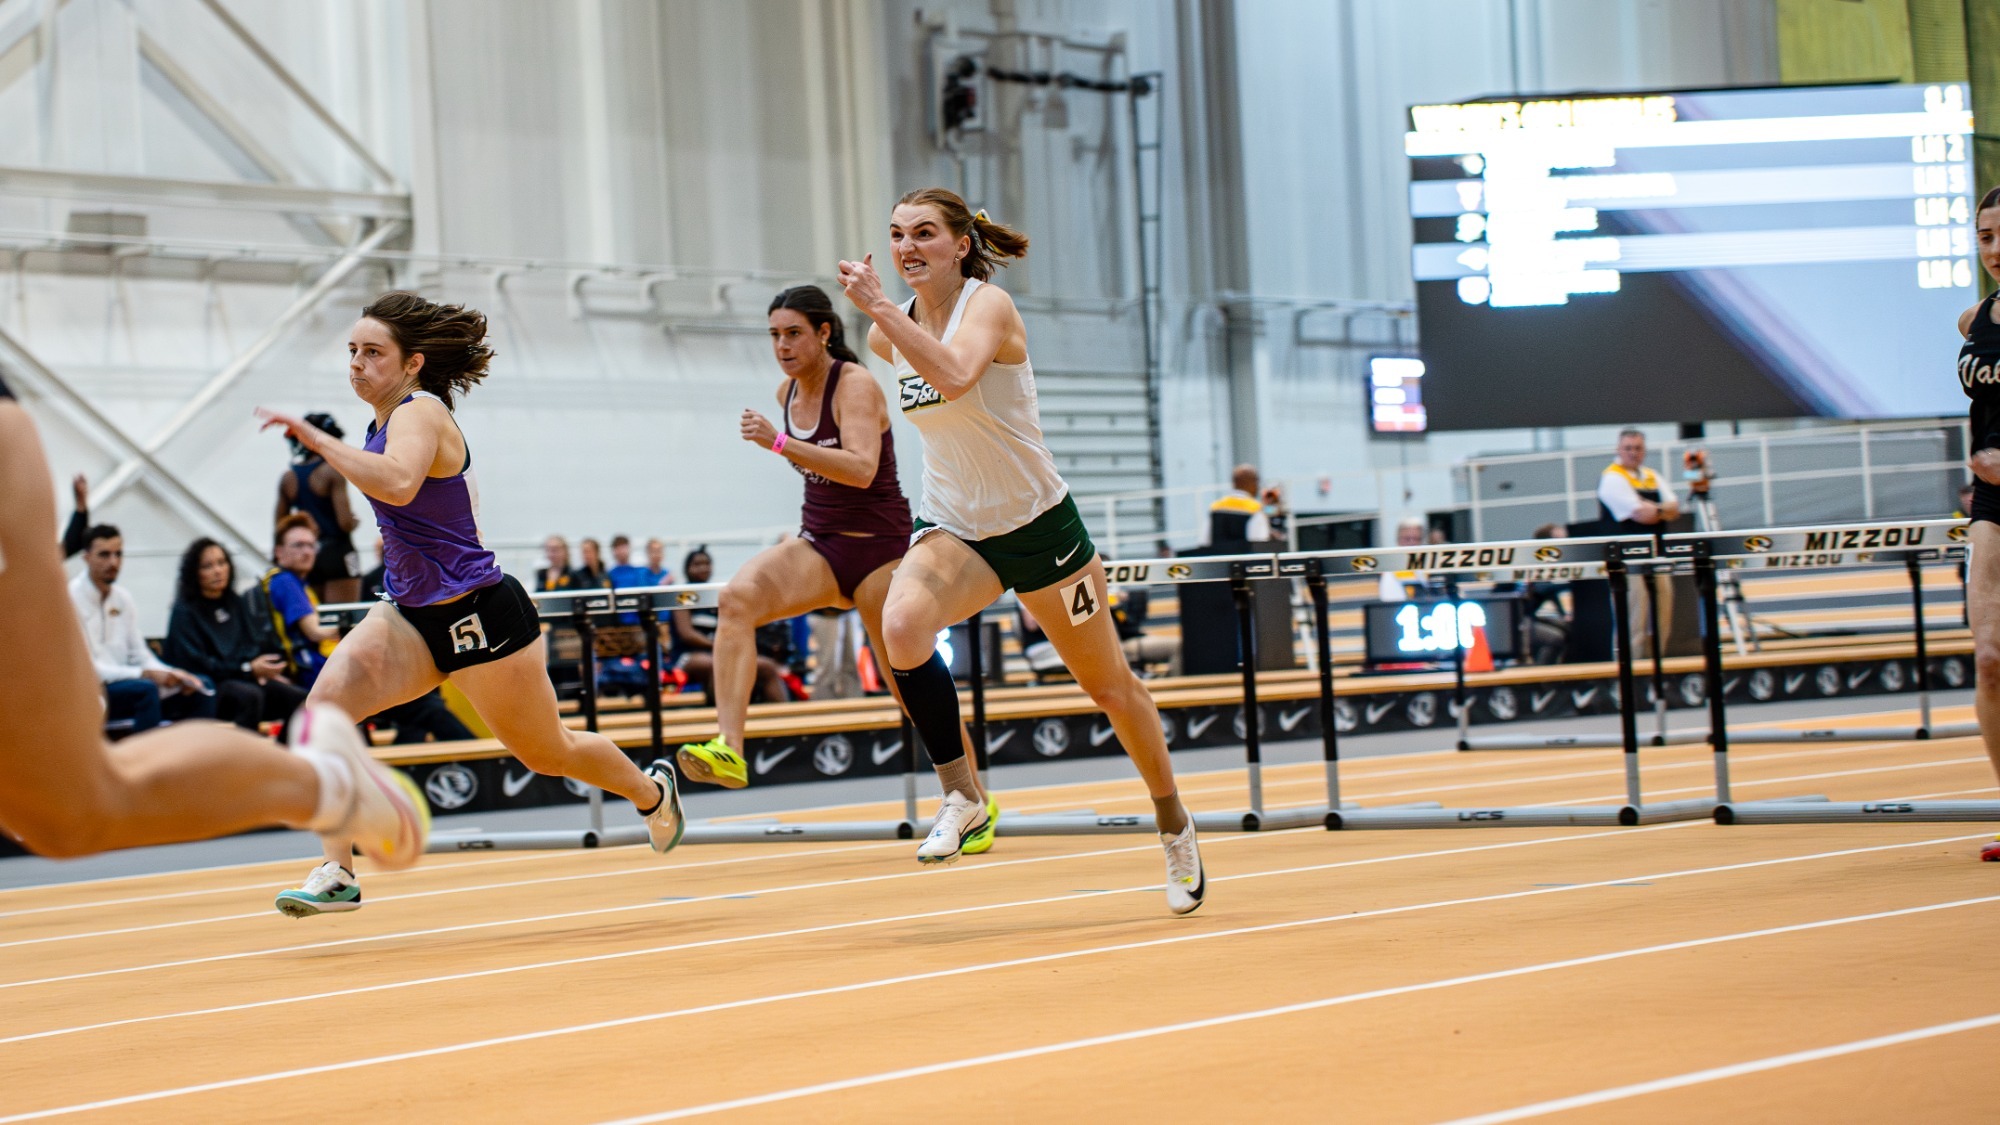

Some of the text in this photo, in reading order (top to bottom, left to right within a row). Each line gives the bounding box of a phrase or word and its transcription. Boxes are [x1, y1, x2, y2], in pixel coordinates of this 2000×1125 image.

[1947, 134, 1965, 162] 2
[1950, 196, 1969, 225] 4
[1952, 258, 1972, 287] 6
[1805, 526, 1925, 551] MIZZOU
[1407, 547, 1515, 570] MIZZOU
[1622, 547, 1650, 555] UCS
[1766, 553, 1843, 567] MIZZOU
[1512, 567, 1584, 580] MIZZOU
[1071, 581, 1094, 616] 4
[454, 619, 480, 652] 5
[1458, 810, 1504, 821] UCS
[1862, 803, 1914, 813] UCS
